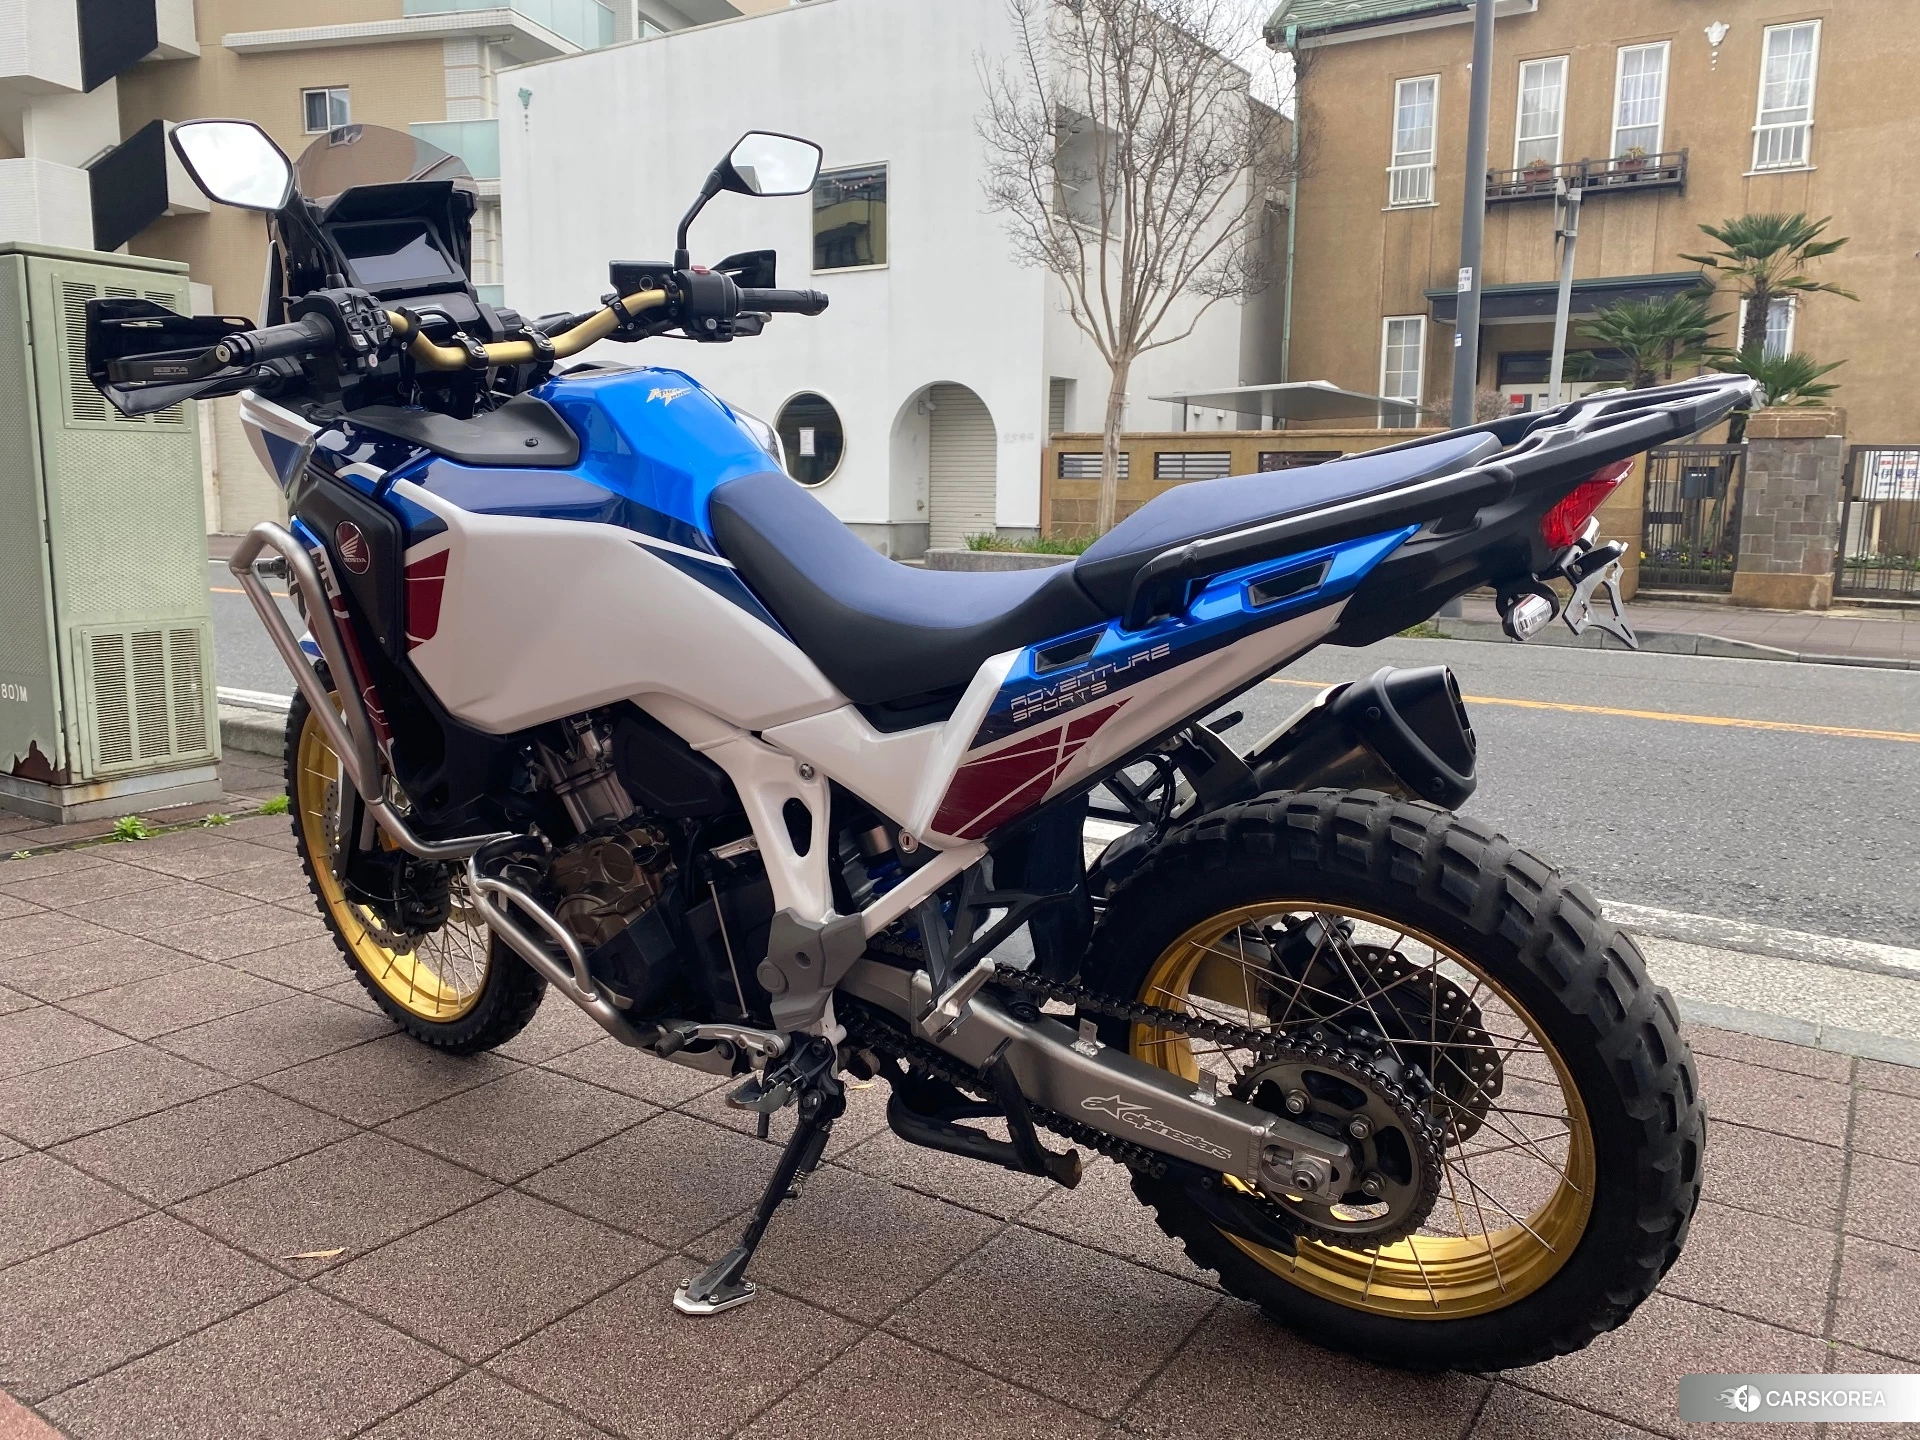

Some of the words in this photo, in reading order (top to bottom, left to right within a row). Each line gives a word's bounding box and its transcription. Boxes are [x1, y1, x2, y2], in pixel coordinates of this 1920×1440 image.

[1010, 642, 1171, 710] ADVENTURE
[1012, 680, 1108, 723] SPORTS
[1121, 1111, 1233, 1160] alpinestars
